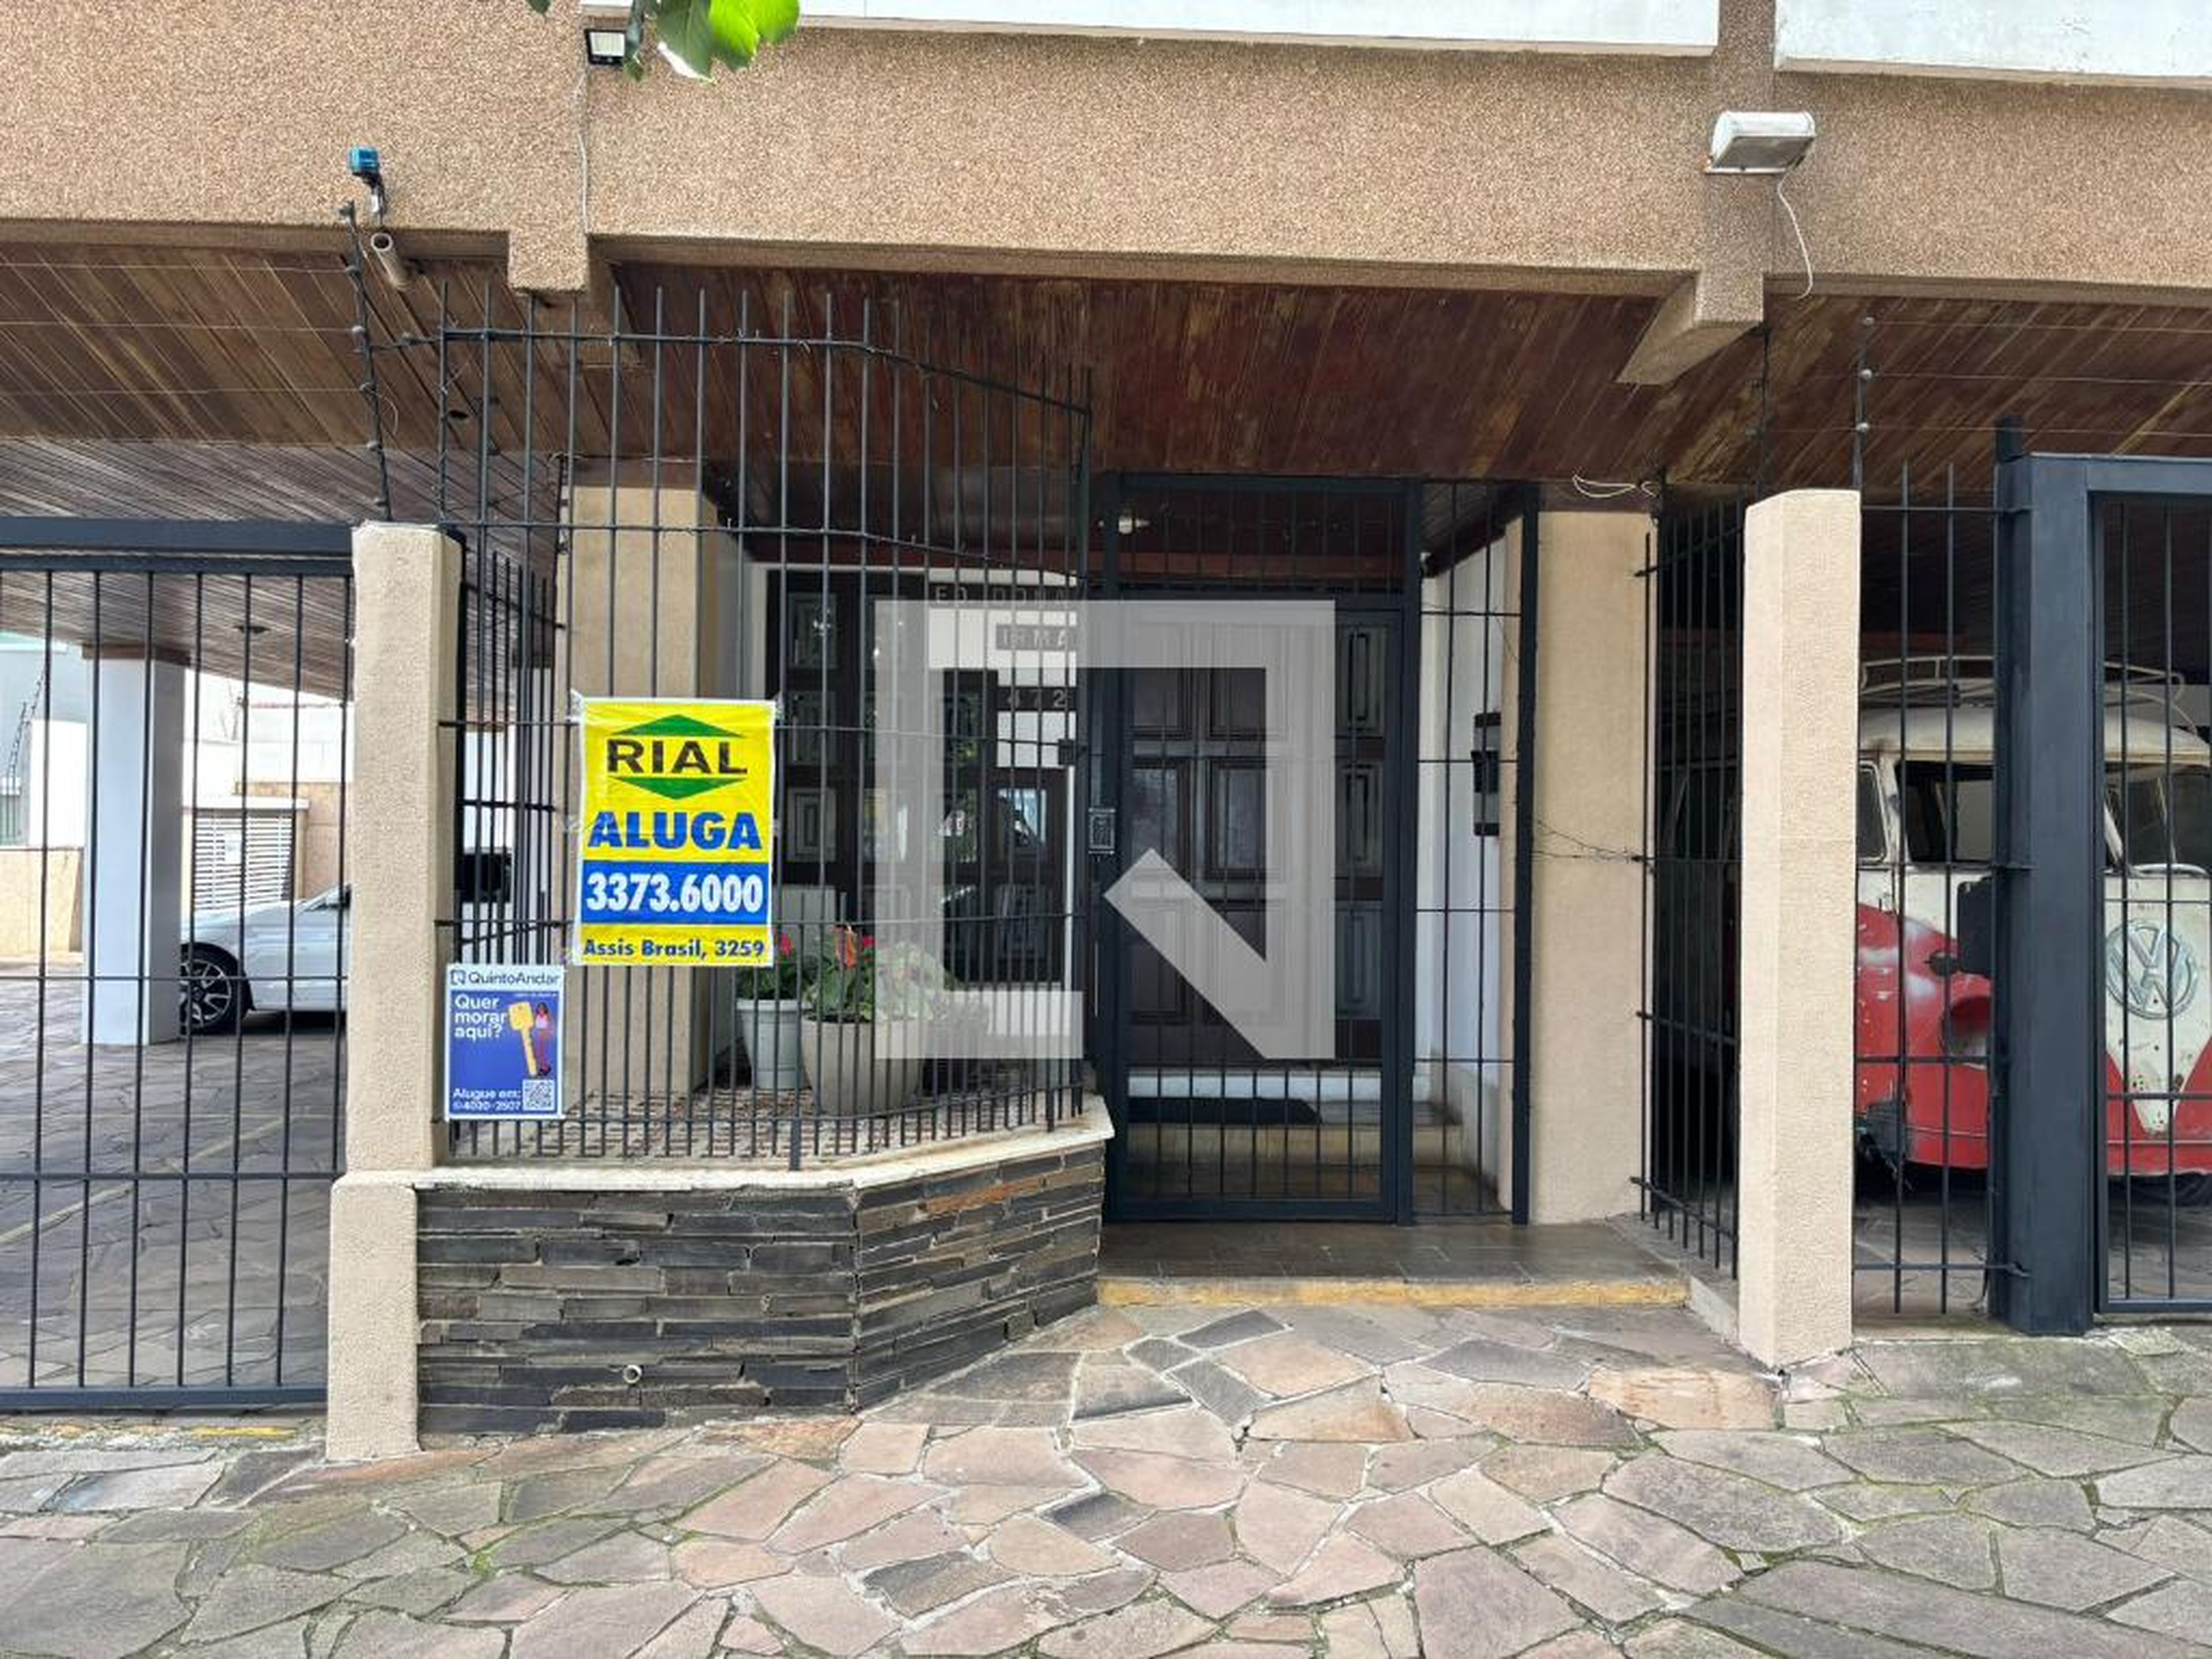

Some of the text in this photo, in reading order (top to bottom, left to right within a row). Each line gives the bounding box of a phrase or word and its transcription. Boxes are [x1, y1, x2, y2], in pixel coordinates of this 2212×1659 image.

[607, 740, 748, 774] RIAL
[588, 811, 762, 850] ALUGA
[586, 872, 764, 913] 3373.6000
[584, 939, 765, 959] Assis Brasil, 3259
[468, 971, 559, 985] QuintoAndar
[454, 994, 500, 1009] Quer
[454, 1011, 506, 1024] morar
[454, 1024, 502, 1041] aqui?
